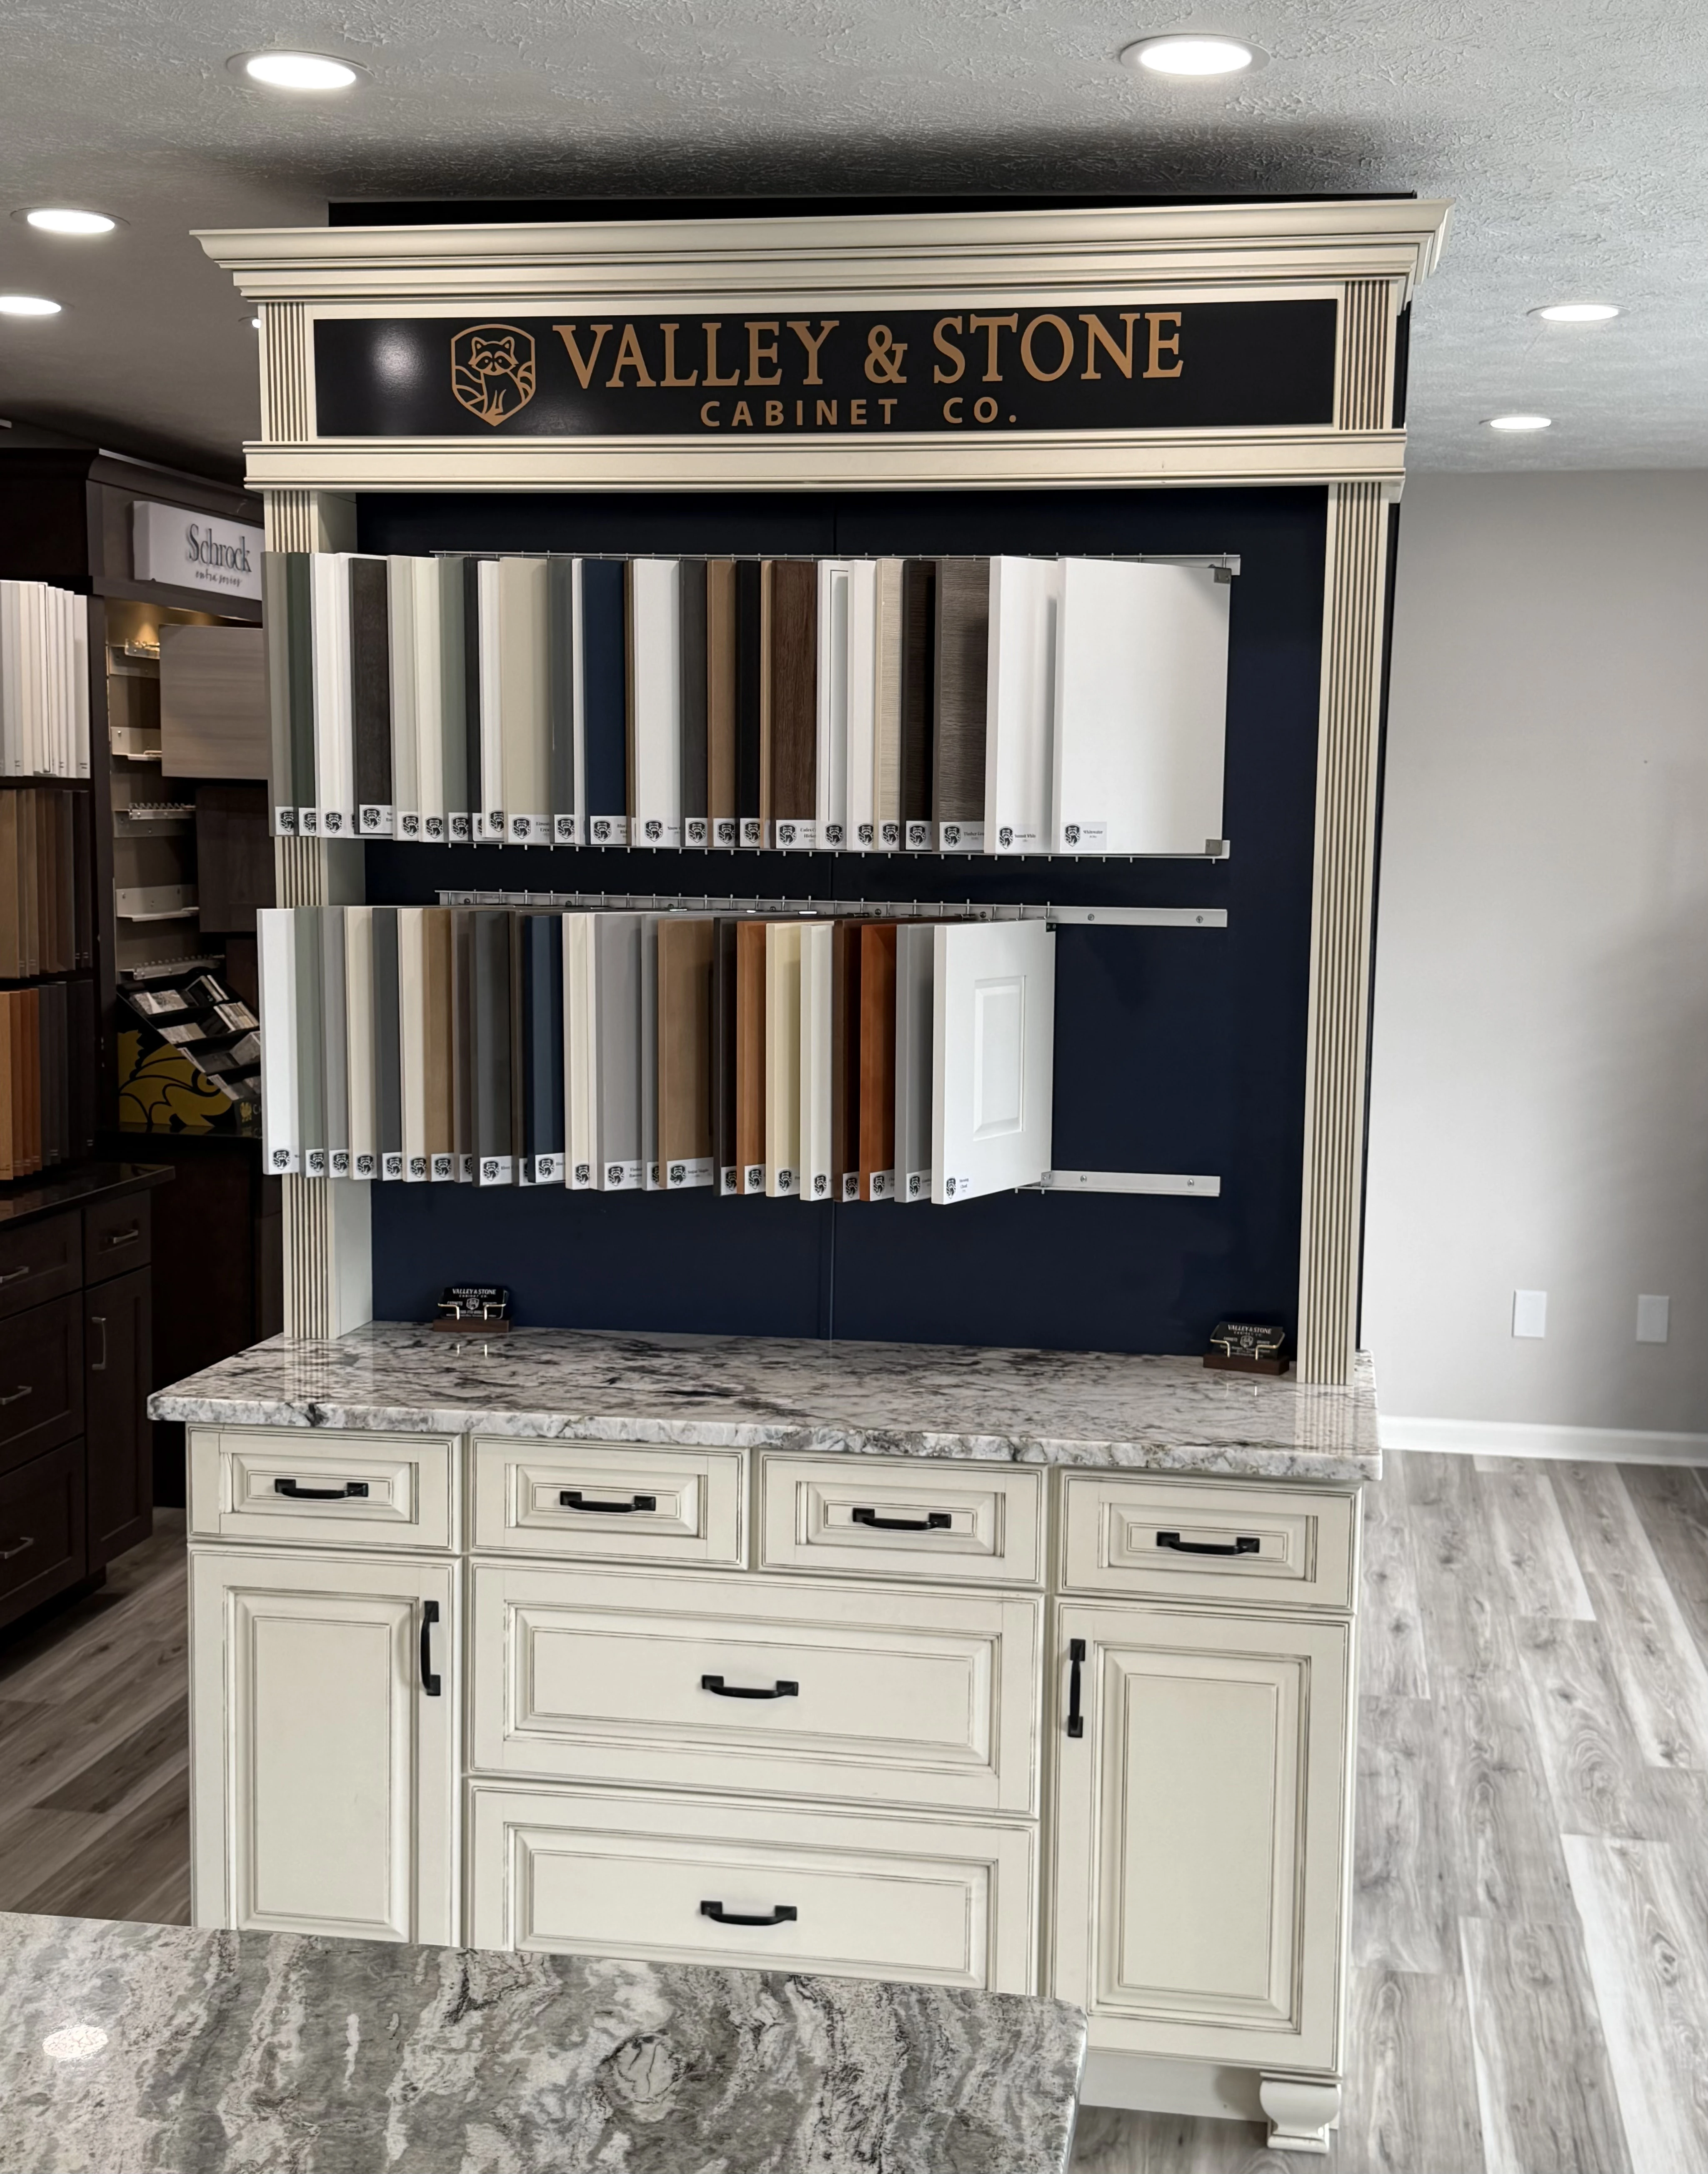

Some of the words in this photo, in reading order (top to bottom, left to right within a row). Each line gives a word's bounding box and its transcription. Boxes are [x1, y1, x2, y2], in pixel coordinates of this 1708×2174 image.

[553, 322, 838, 389] VALLEY
[865, 326, 906, 383] &
[934, 312, 1183, 383] STONE
[701, 399, 896, 427] CABINET
[943, 397, 1016, 424] CO.
[189, 524, 252, 572] Schrock
